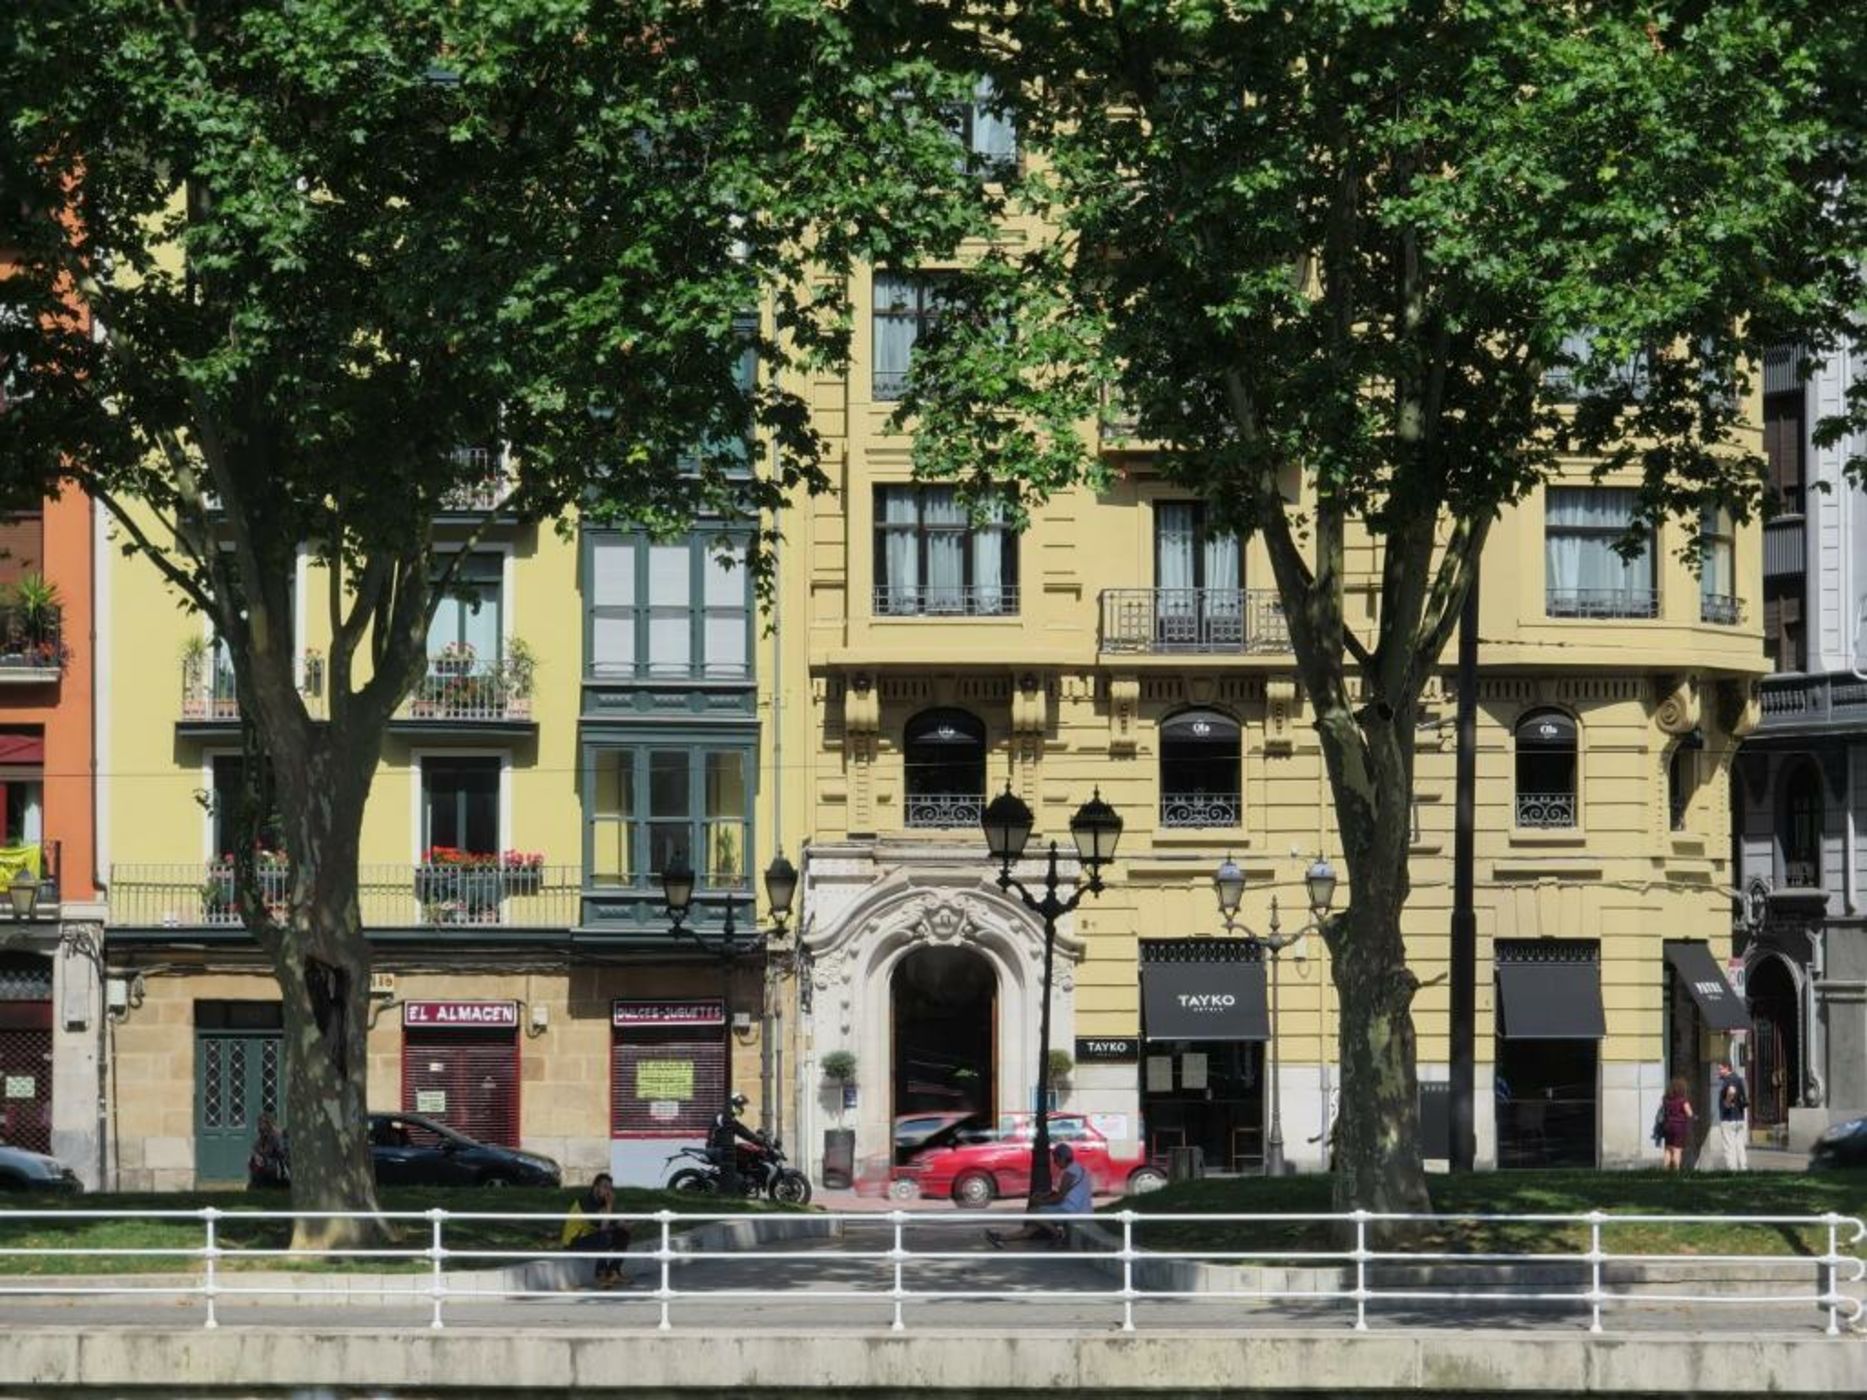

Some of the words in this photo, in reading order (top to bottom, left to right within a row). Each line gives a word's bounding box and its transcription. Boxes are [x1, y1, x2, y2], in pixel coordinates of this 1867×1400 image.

[1177, 994, 1236, 1007] TAYKO
[408, 1005, 428, 1021] EL
[436, 1005, 514, 1022] ALMACEN
[1086, 1042, 1127, 1052] TAYKO
